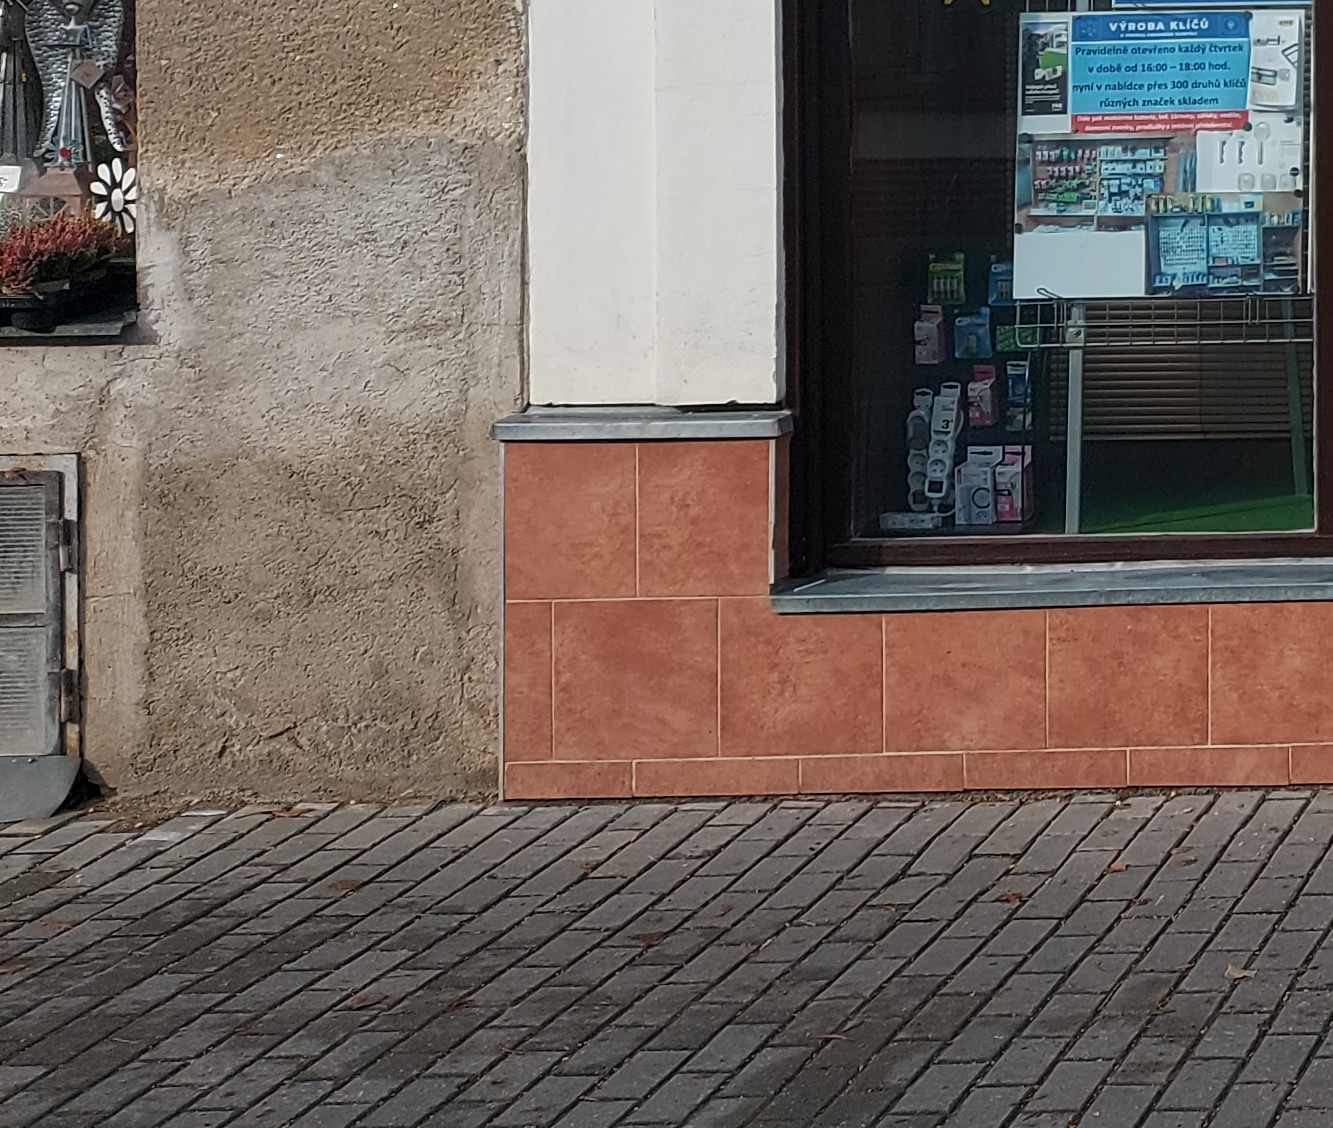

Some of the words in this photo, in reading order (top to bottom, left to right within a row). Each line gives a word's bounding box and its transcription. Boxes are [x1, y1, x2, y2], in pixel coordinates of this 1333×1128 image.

[1109, 21, 1165, 32] VÝROBA
[1170, 17, 1209, 30] KLÍČŮ
[1075, 45, 1129, 56] Pravidelně
[1131, 44, 1176, 54] otevřeno
[1178, 44, 1207, 55] každý
[1208, 43, 1244, 53] čtvrtek
[1096, 62, 1122, 73] době
[1124, 62, 1138, 72] od
[1141, 63, 1168, 72] 16:00
[1179, 62, 1206, 71] 18:00
[1208, 61, 1231, 71] hod.
[1073, 82, 1094, 93] nyní
[1105, 80, 1145, 91] nabídce
[1147, 81, 1169, 92] přes
[1170, 80, 1189, 90] 300
[1191, 79, 1221, 89] druhů
[1223, 77, 1246, 88] klíčů
[1100, 98, 1139, 109] různých
[1141, 97, 1175, 106] značek
[1177, 95, 1219, 106] skladem
